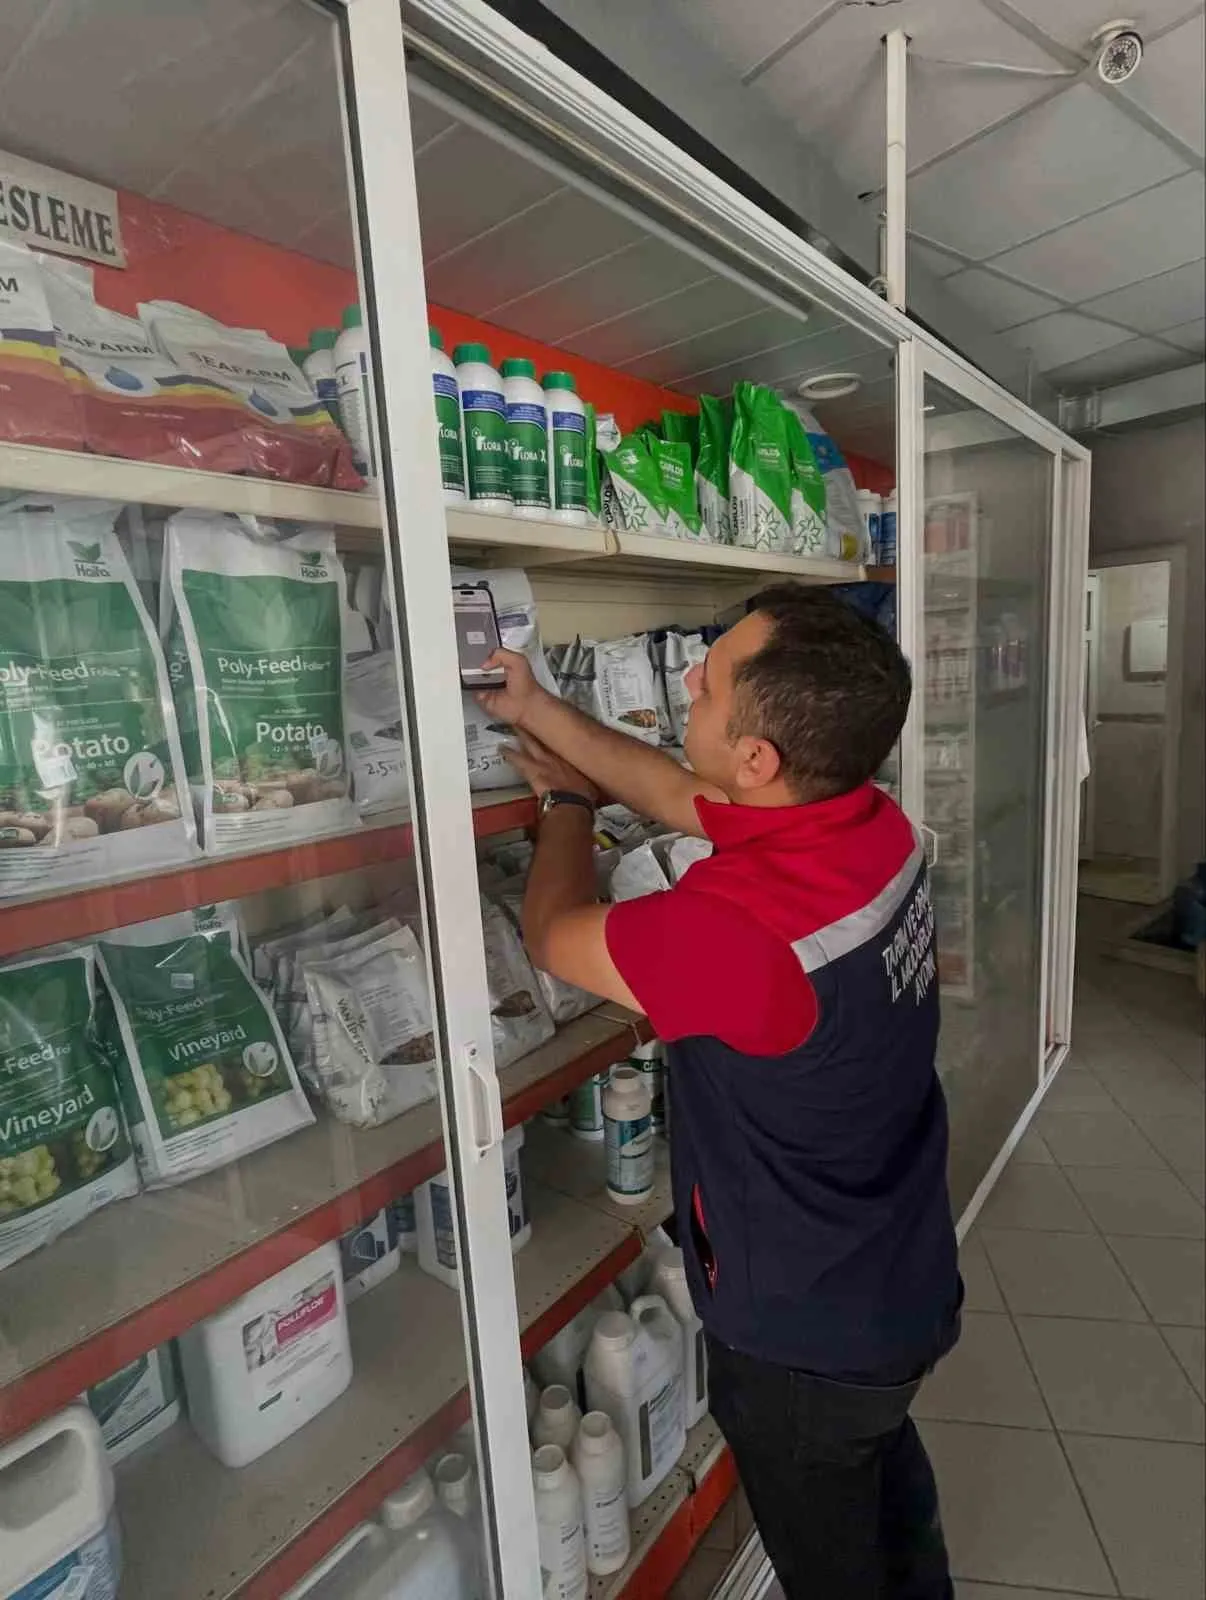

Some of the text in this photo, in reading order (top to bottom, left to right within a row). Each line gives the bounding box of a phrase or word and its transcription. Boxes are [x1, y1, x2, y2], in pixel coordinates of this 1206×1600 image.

[217, 655, 301, 680] Poly-Feed
[256, 721, 325, 744] Potato
[167, 1024, 248, 1061] Vineyard
[0, 1083, 94, 1141] Vineyard
